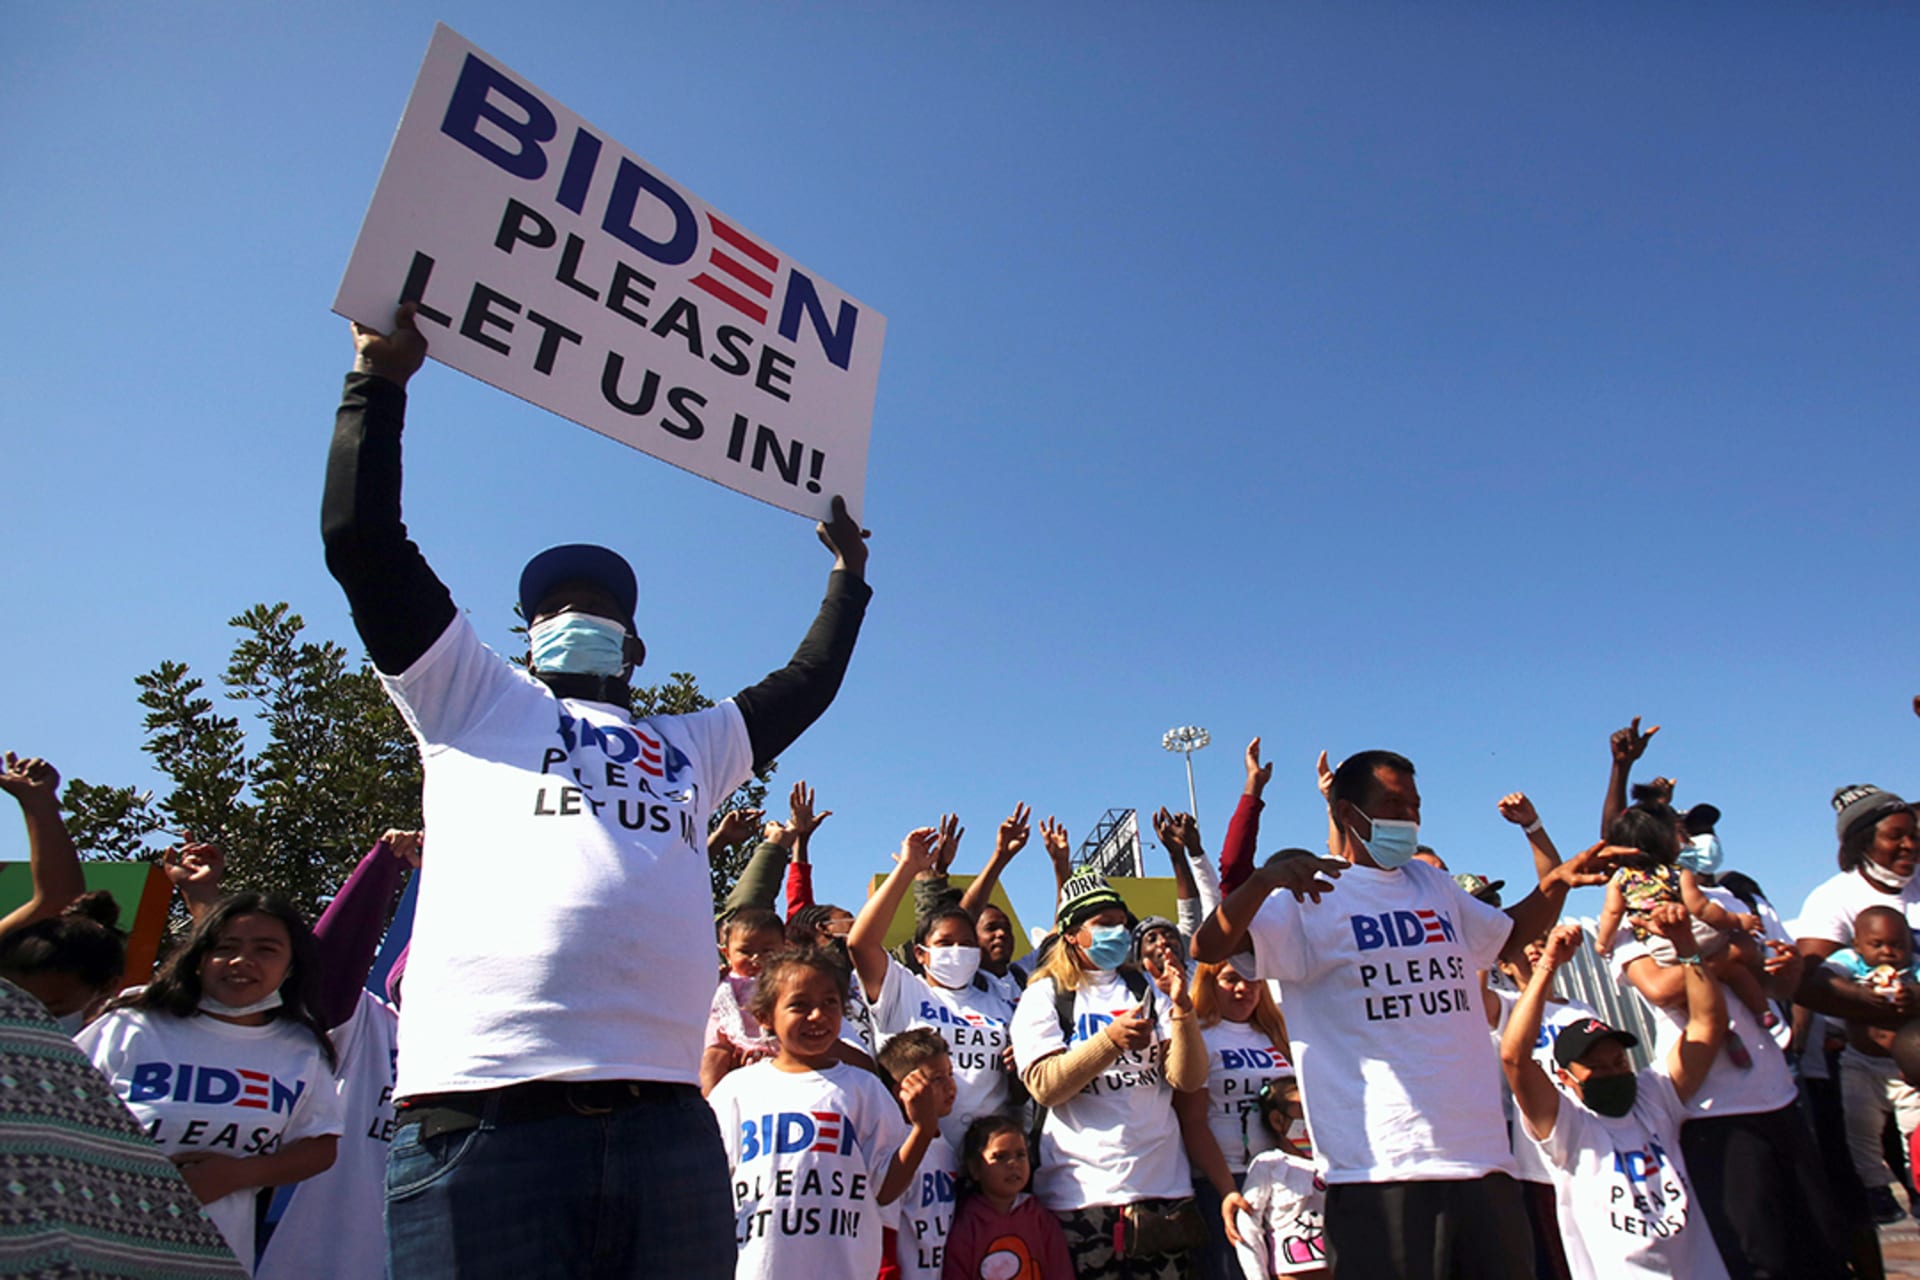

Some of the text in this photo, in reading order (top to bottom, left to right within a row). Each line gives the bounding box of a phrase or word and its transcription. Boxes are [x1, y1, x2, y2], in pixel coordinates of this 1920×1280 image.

[441, 52, 858, 371] BIDEN
[494, 198, 796, 402] PLEASE
[398, 250, 825, 495] LET US IN!
[618, 799, 671, 833] US
[1063, 874, 1098, 900] YORK
[1350, 909, 1459, 951] BIDEN
[1365, 994, 1413, 1021] LET
[1419, 989, 1452, 1015] US
[958, 1052, 986, 1070] US
[1220, 1046, 1289, 1069] BIDE
[130, 1062, 306, 1117] BIDEN
[1105, 1071, 1136, 1091] US
[150, 1118, 282, 1156] LEAS
[367, 1116, 394, 1143] LE
[741, 1111, 863, 1163] BIDEN
[735, 1168, 867, 1207] PLEASE
[922, 1169, 958, 1208] BID
[781, 1207, 821, 1236] US
[829, 1208, 861, 1238] IN!
[1611, 1211, 1648, 1238] LET
[917, 1246, 943, 1269] LE
